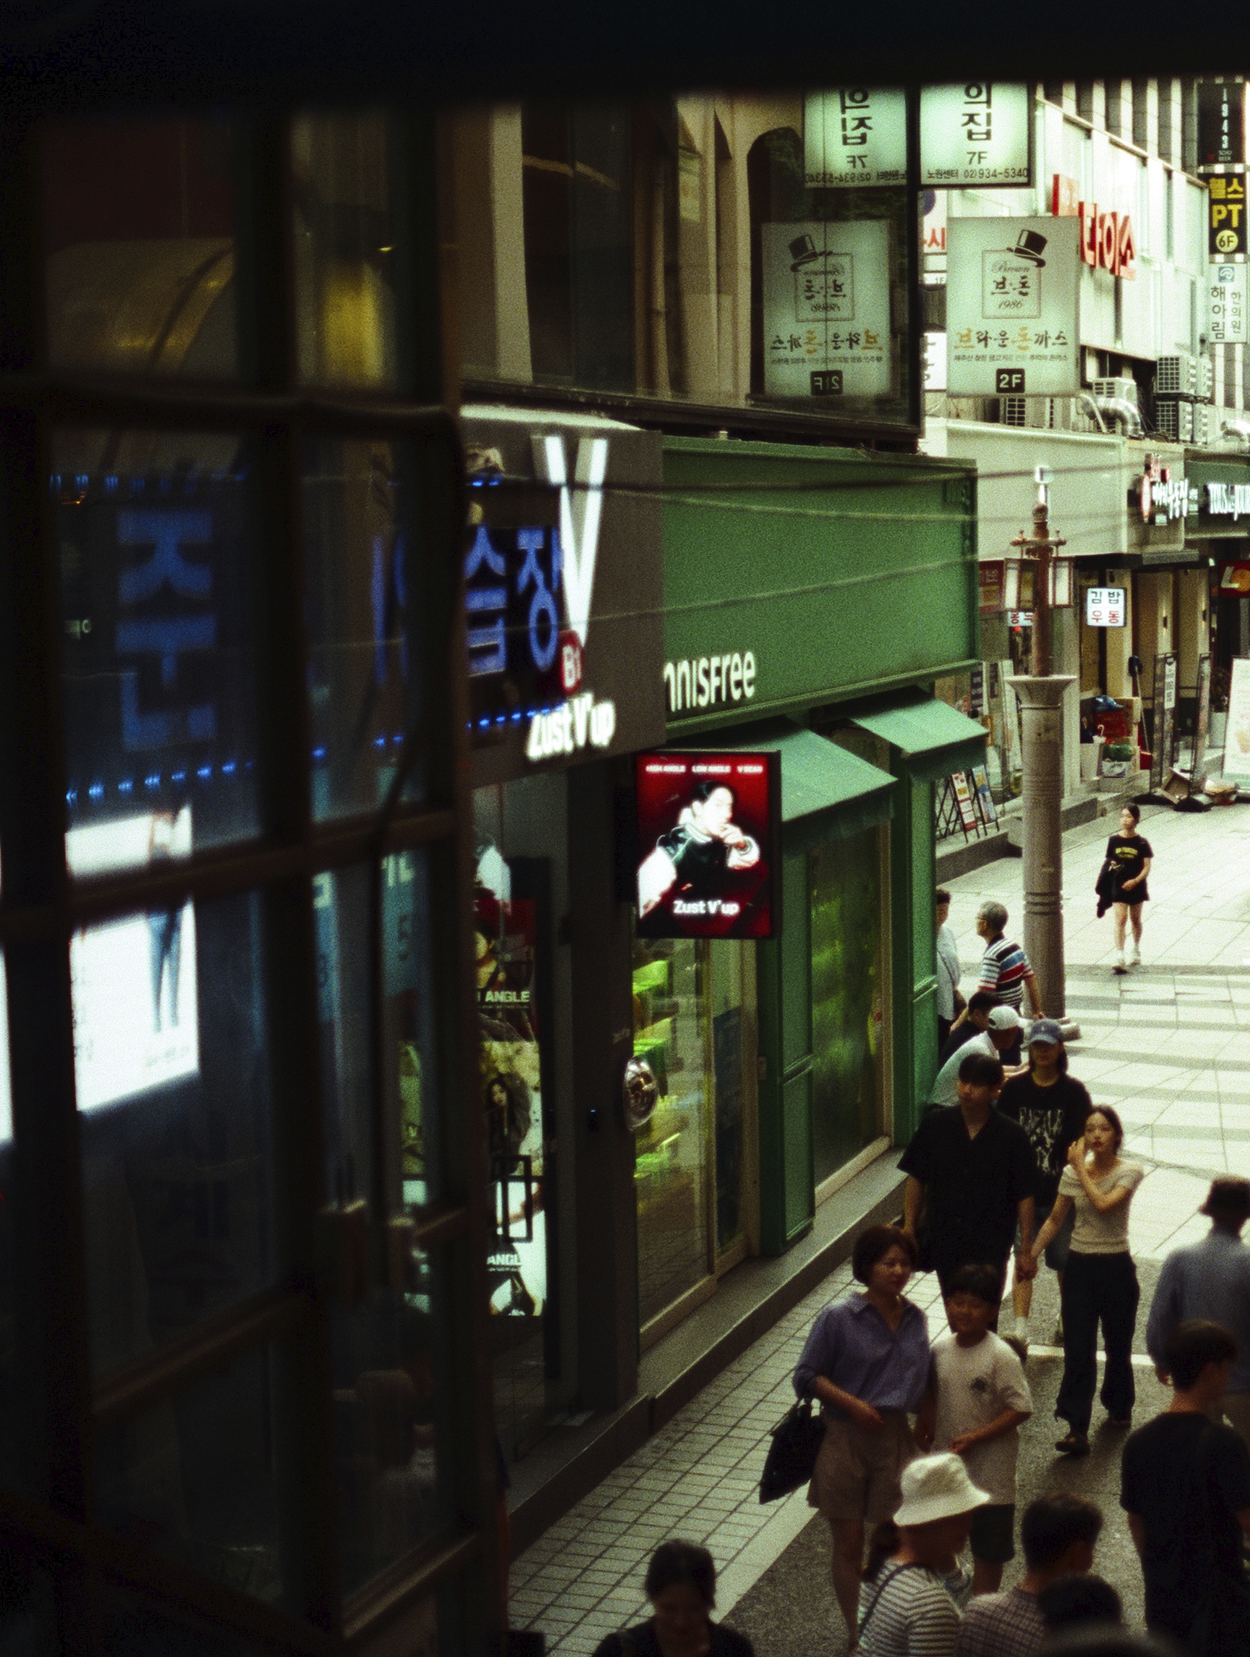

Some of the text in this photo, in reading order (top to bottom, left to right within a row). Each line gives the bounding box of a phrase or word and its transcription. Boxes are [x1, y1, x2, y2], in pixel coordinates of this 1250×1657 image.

[966, 151, 988, 165] 7F
[1209, 181, 1244, 200] 헬스
[1211, 204, 1243, 229] PT
[1218, 235, 1235, 249] 6F
[1211, 286, 1226, 340] 해아림
[1231, 291, 1242, 334] 한의원
[999, 374, 1022, 388] 2F
[1090, 591, 1121, 605] 김밥
[1090, 610, 1120, 624] 우동
[672, 901, 705, 914] Zust
[485, 991, 531, 1003] ANGLE
